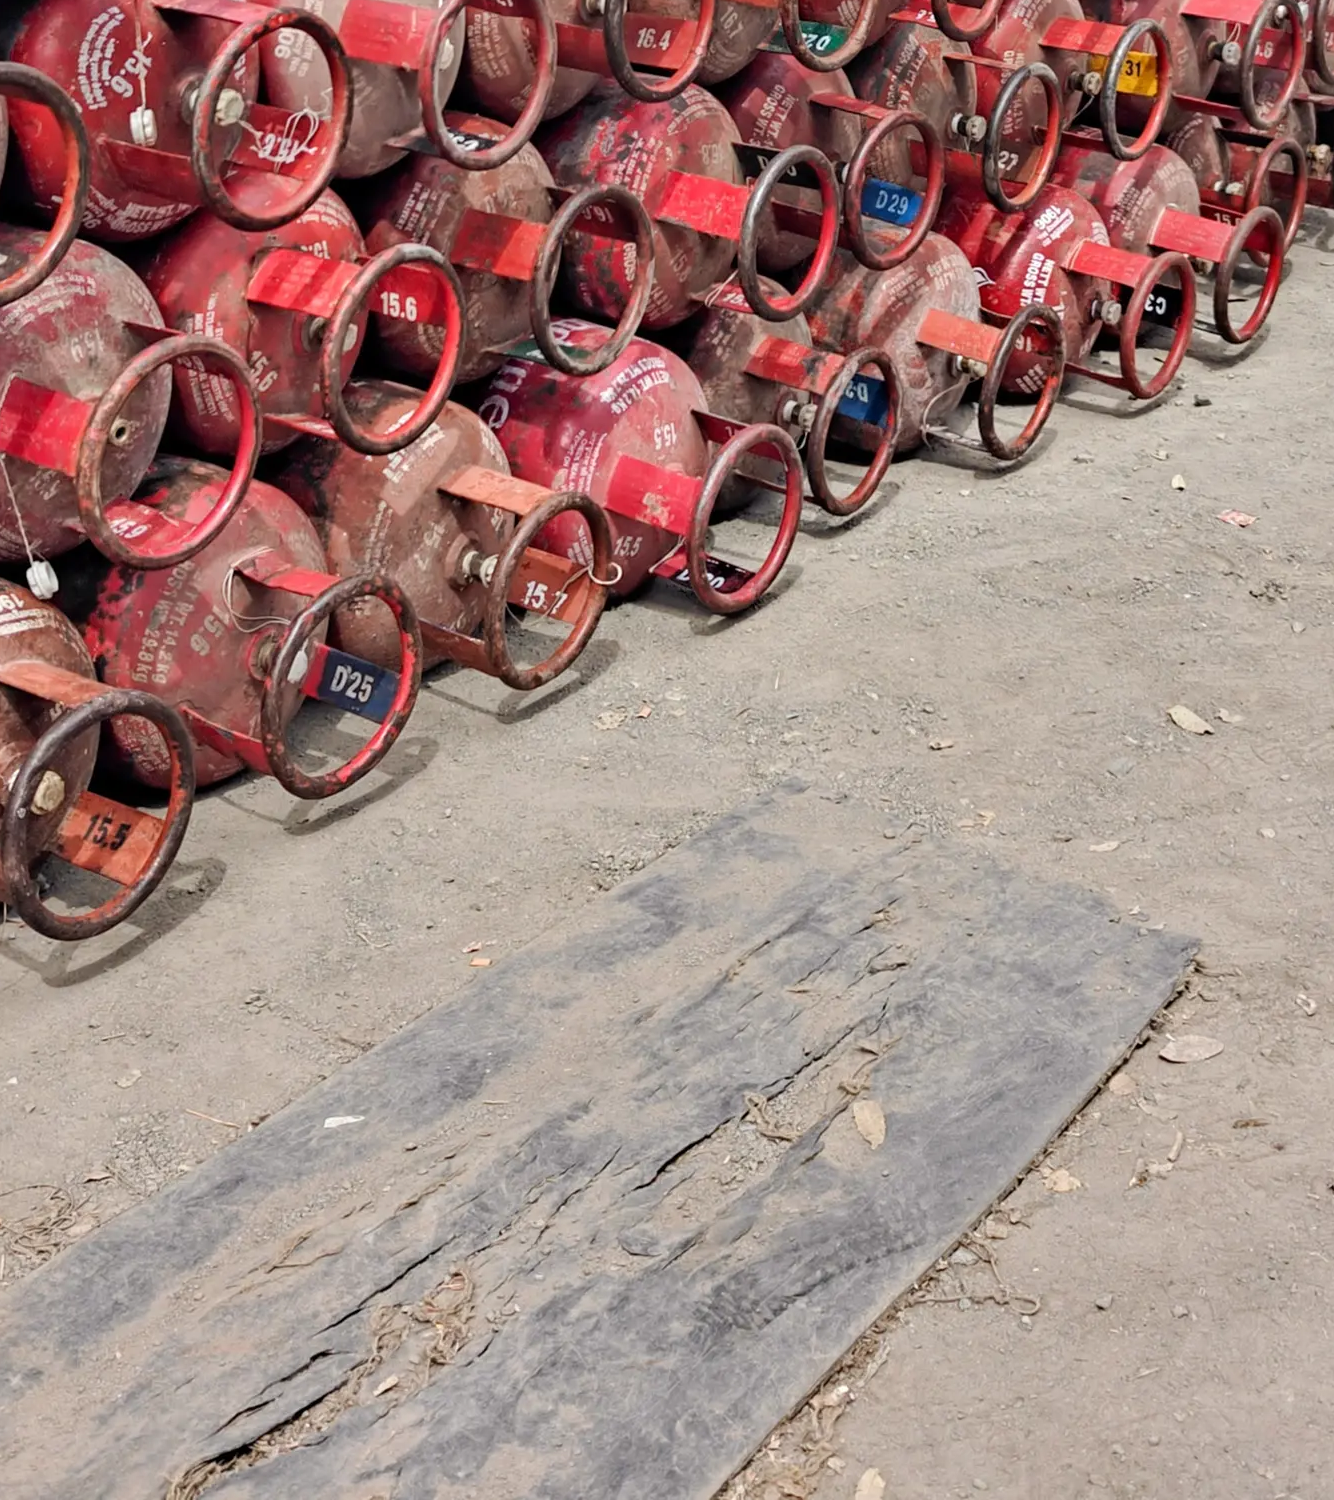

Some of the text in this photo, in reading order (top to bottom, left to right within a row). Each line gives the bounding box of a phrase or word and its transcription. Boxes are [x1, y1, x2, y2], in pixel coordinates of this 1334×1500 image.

[719, 6, 745, 38] 16.7
[636, 27, 672, 51] 16.4
[109, 49, 152, 99] 15.6
[760, 84, 785, 118] GROSS
[1024, 252, 1045, 288] GROSS
[1038, 259, 1055, 286] NETT
[380, 291, 417, 322] 15.6
[614, 536, 643, 559] 15.5
[163, 561, 191, 599] ROSS
